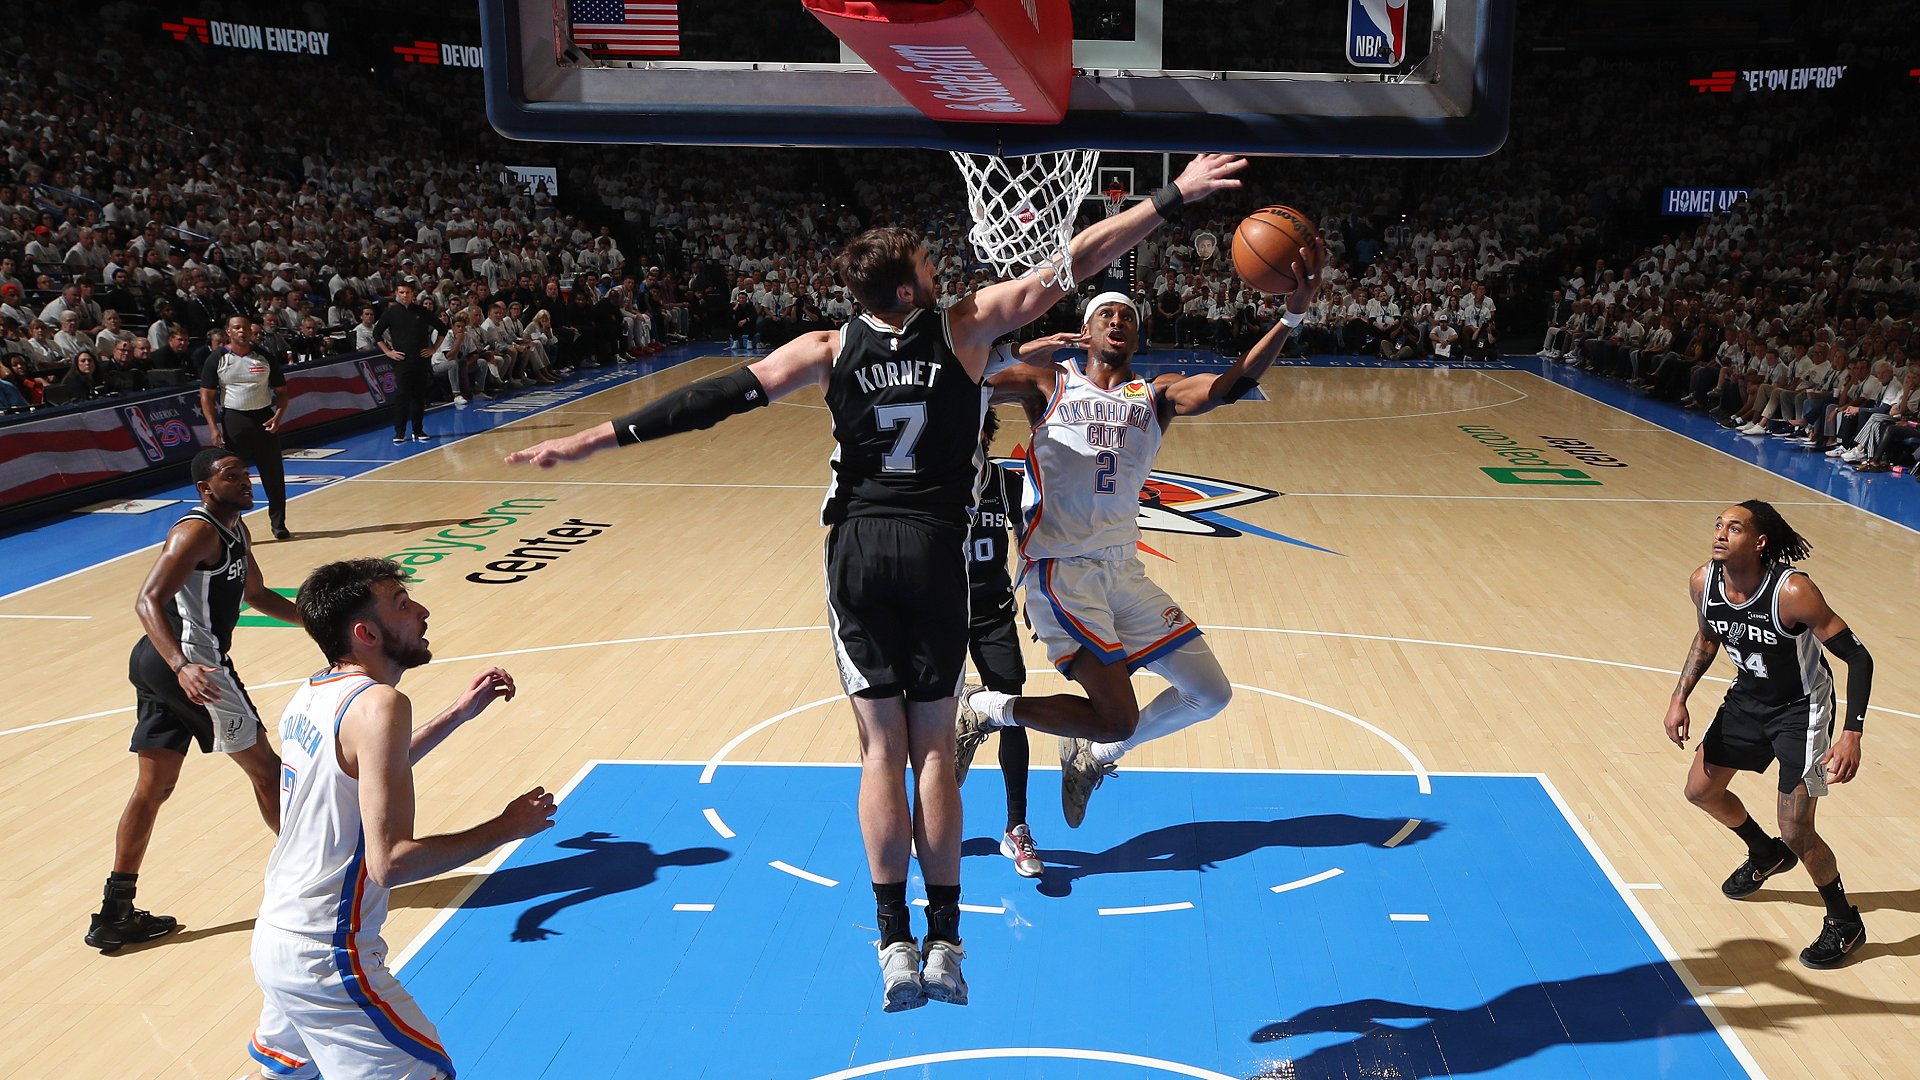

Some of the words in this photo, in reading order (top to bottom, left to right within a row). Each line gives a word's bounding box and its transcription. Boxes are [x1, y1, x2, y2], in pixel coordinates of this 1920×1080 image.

[210, 20, 263, 50] DEVON
[265, 27, 329, 55] ENERGY
[1355, 35, 1383, 57] NBA
[854, 360, 942, 394] KORNET
[1058, 400, 1153, 432] OKLAHOMA
[873, 401, 928, 473] 7
[1086, 423, 1128, 449] CITY
[1457, 425, 1569, 466] paycom
[1538, 435, 1629, 467] center
[1094, 450, 1118, 495] 2
[465, 518, 613, 584] center
